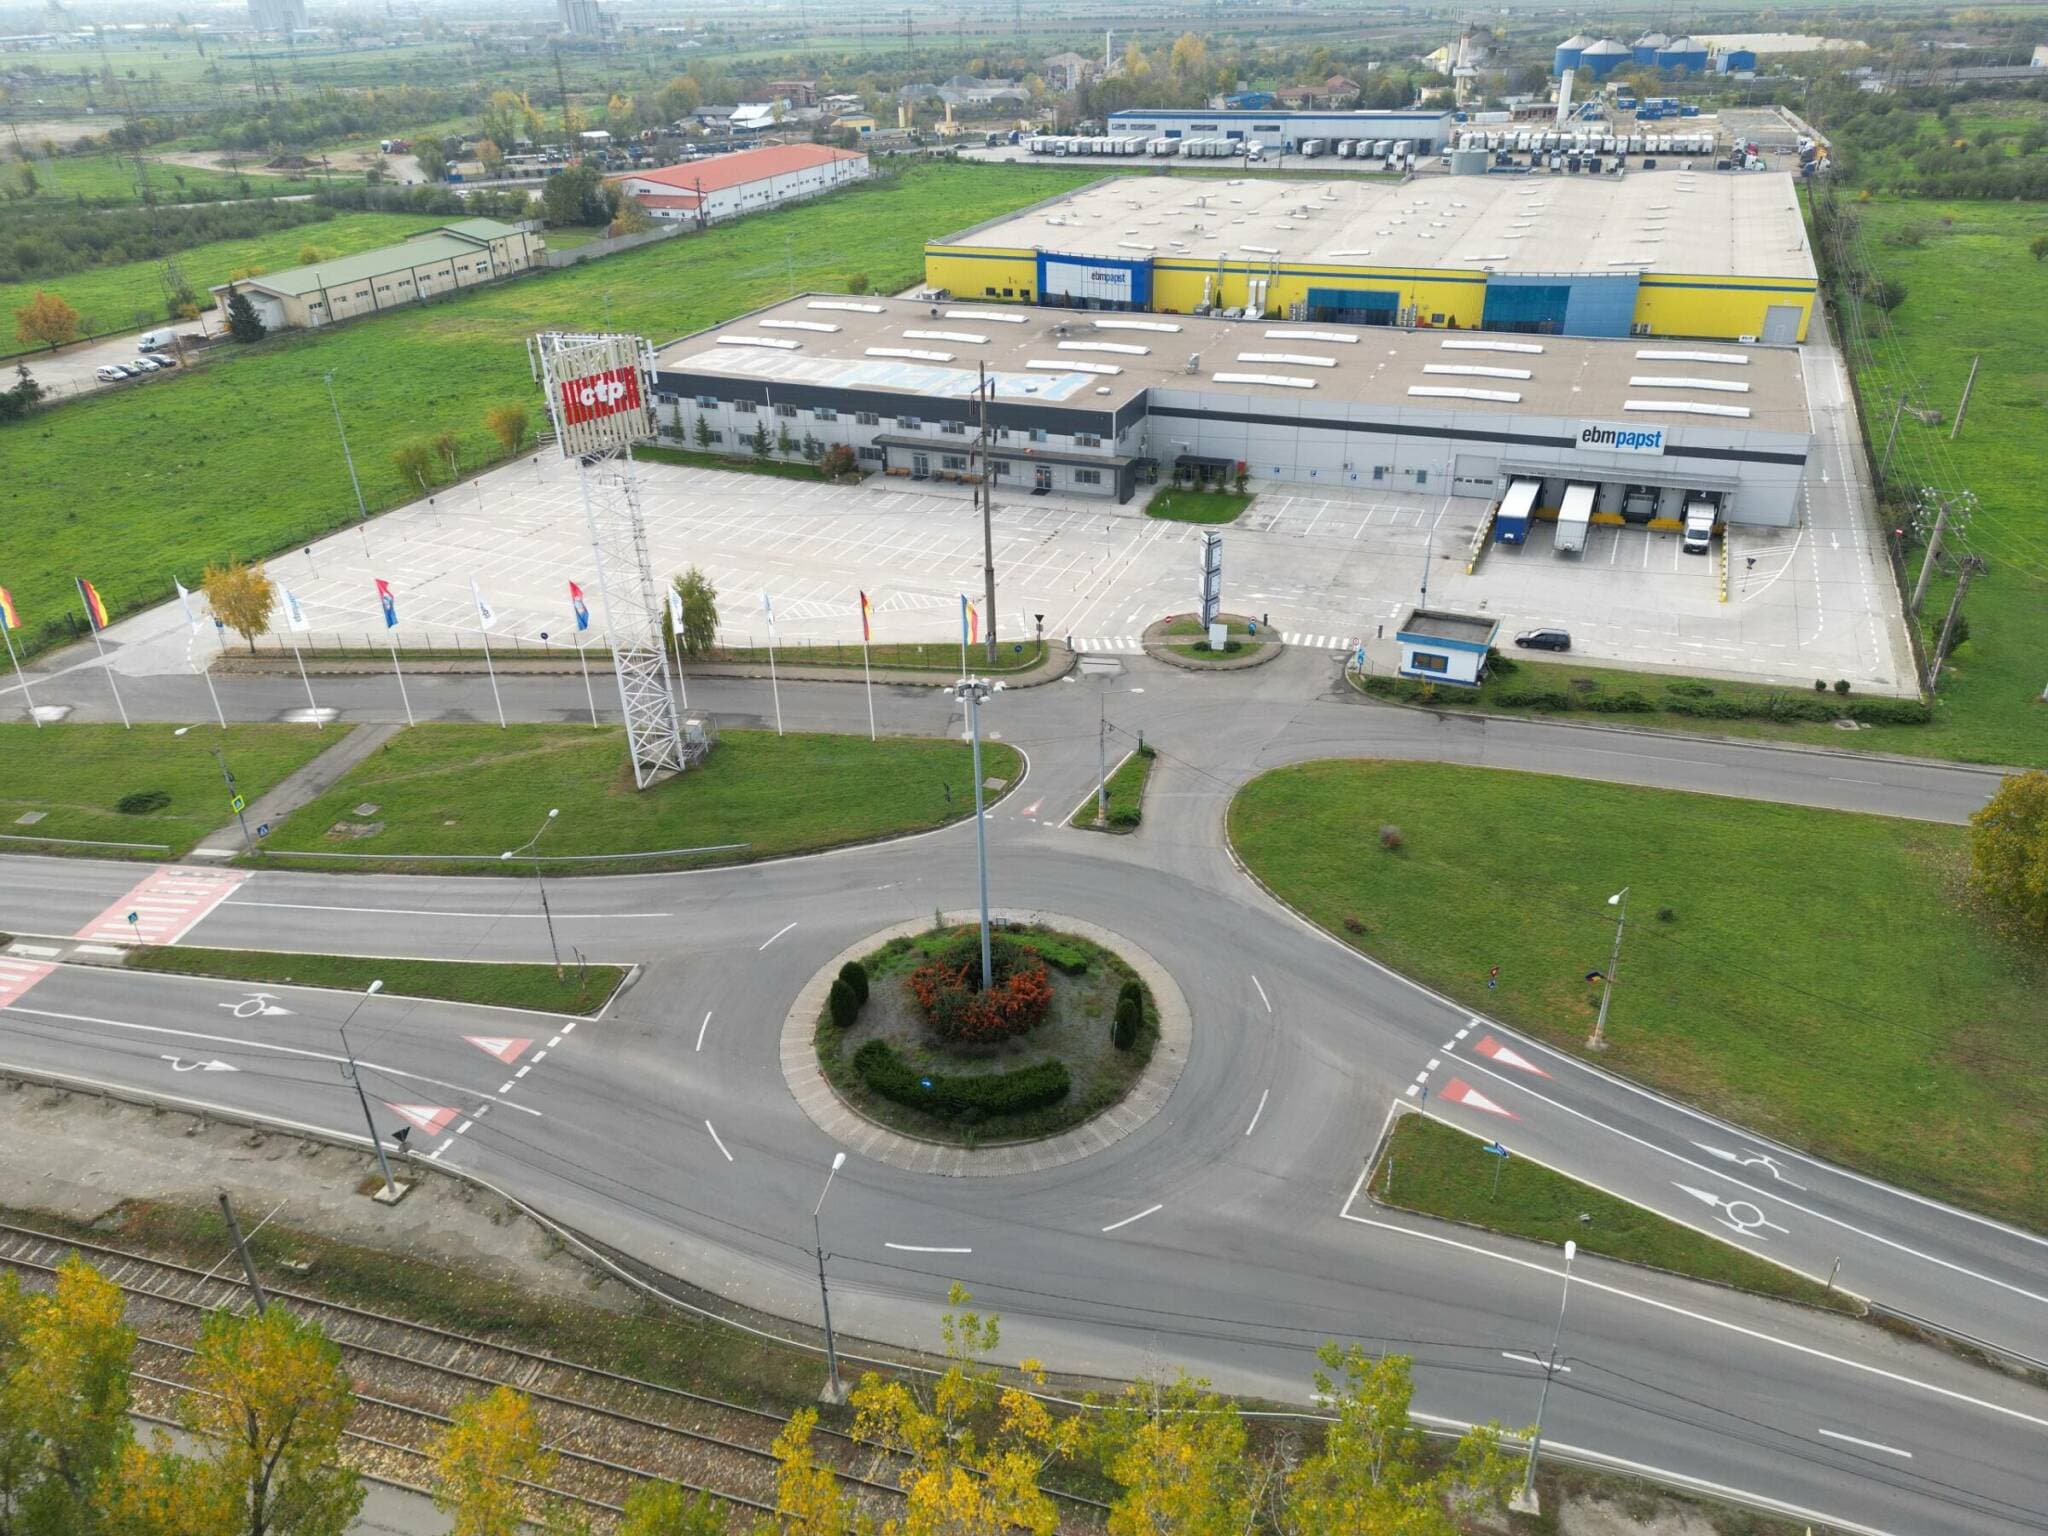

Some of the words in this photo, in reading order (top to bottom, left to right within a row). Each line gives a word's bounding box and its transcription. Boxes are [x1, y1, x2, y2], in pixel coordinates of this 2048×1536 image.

[1091, 271, 1125, 284] ebmpapst
[580, 380, 624, 406] ctp
[1582, 426, 1662, 449] ebmpapst
